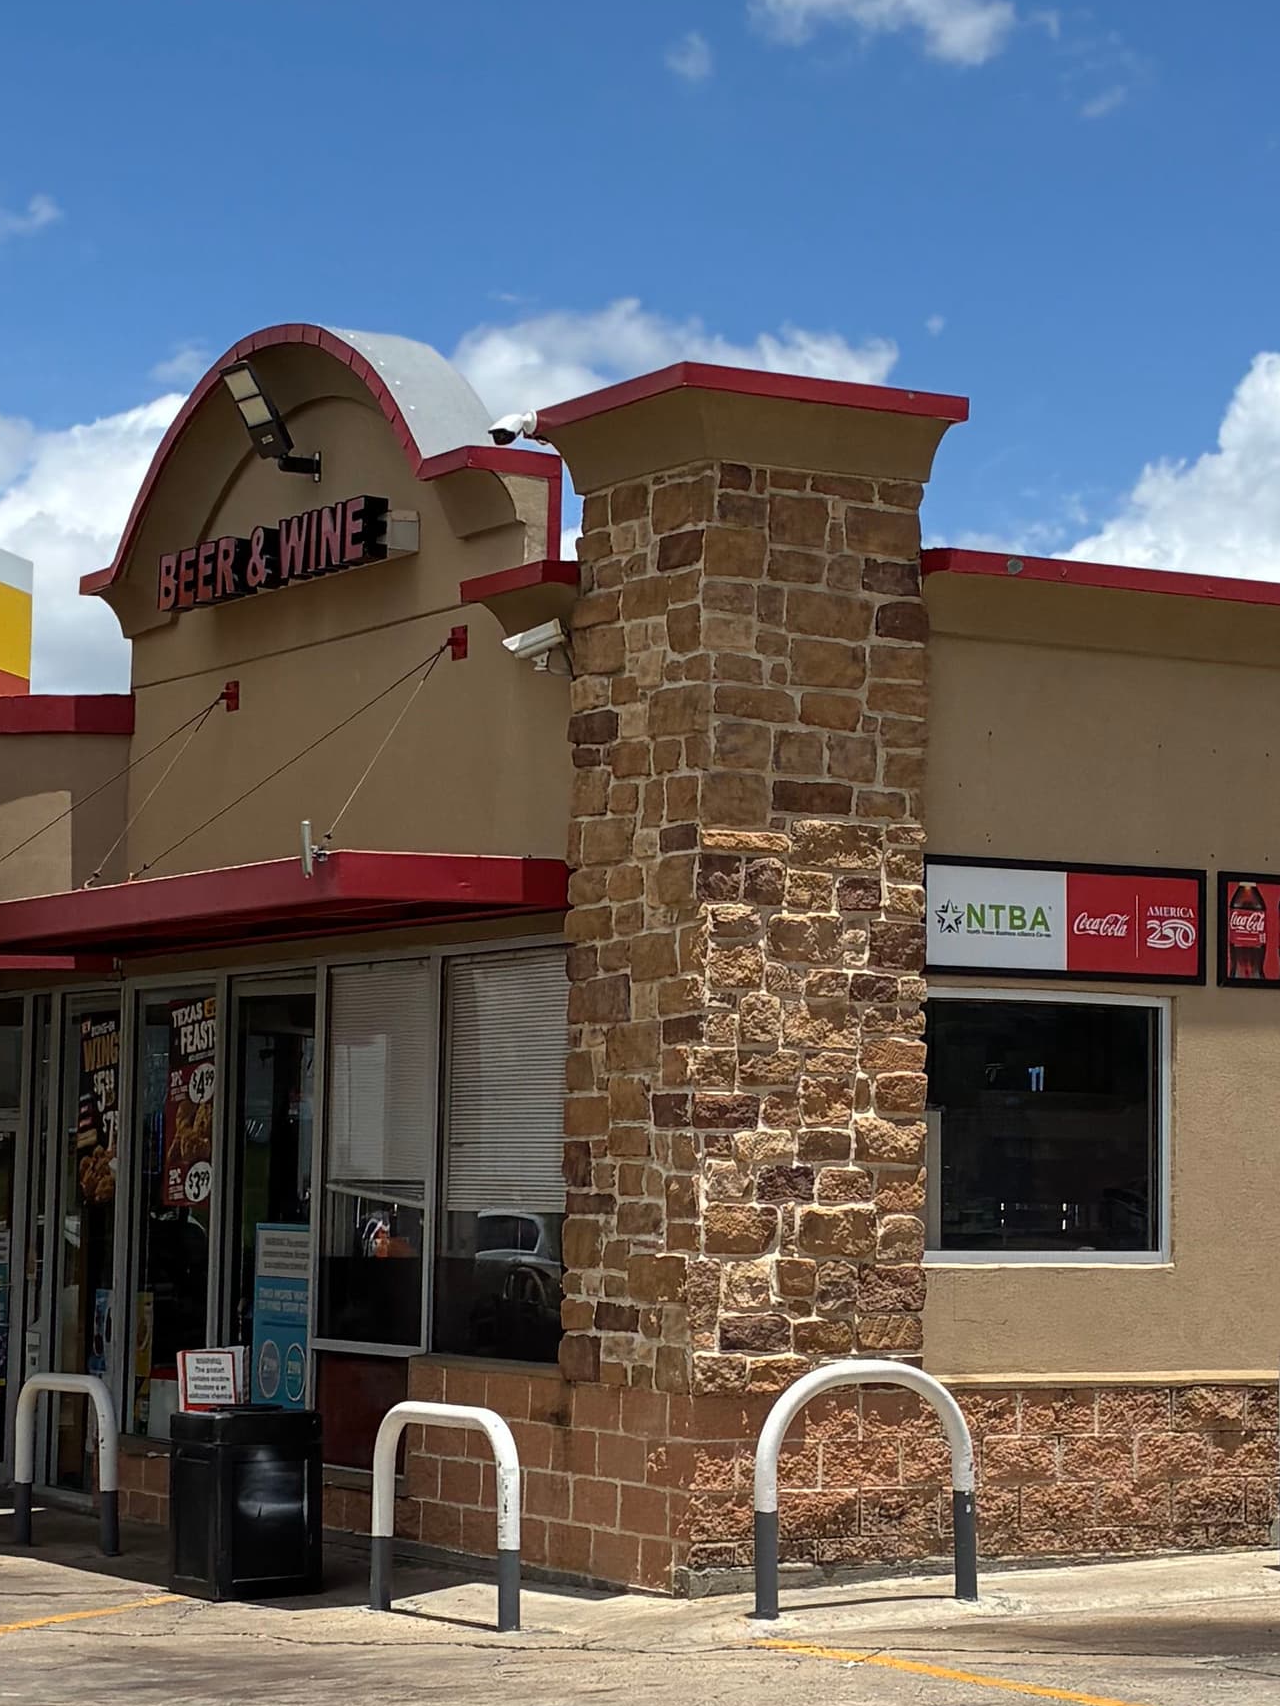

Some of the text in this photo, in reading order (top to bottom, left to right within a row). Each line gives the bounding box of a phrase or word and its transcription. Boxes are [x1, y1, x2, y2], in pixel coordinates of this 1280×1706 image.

[157, 537, 240, 611] BEER
[279, 496, 368, 579] WINE
[966, 903, 1051, 932] NTBA
[1147, 906, 1194, 919] AMERICA
[1146, 919, 1196, 949] 250
[171, 1001, 203, 1029] TEXAS
[180, 1019, 216, 1056] FEAST
